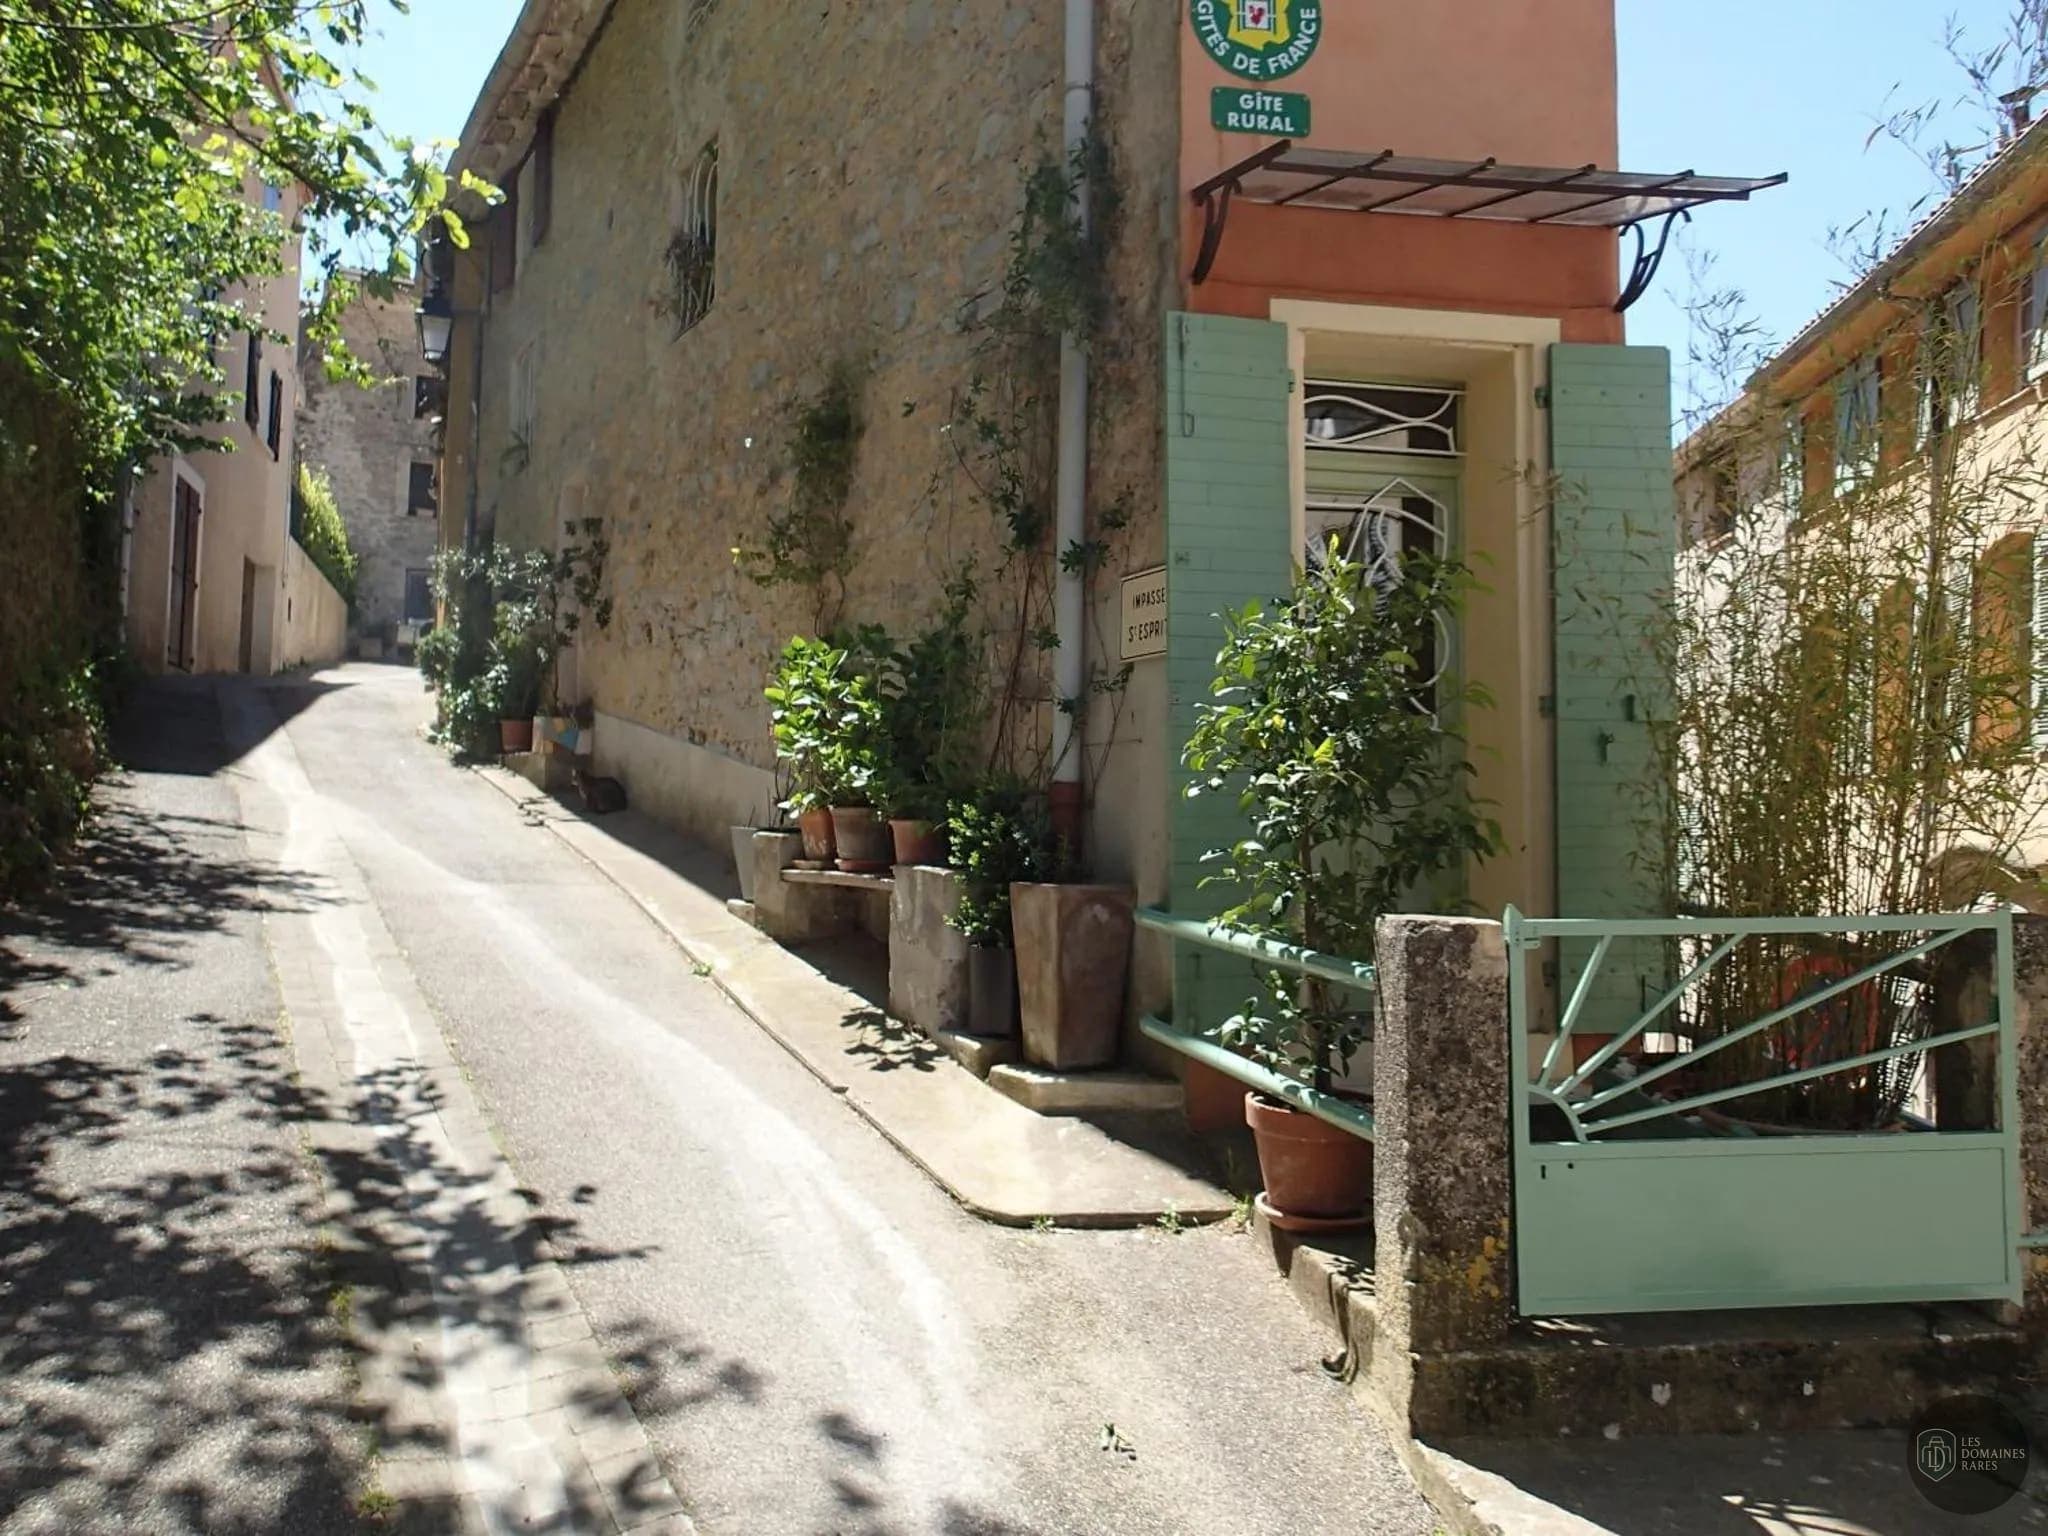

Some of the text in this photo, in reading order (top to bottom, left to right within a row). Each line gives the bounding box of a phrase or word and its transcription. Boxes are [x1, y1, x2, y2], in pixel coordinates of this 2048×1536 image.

[1232, 52, 1260, 74] DE
[1266, 8, 1316, 74] FRANCE
[1227, 112, 1295, 132] RURAL
[1132, 587, 1166, 609] IMPASSE
